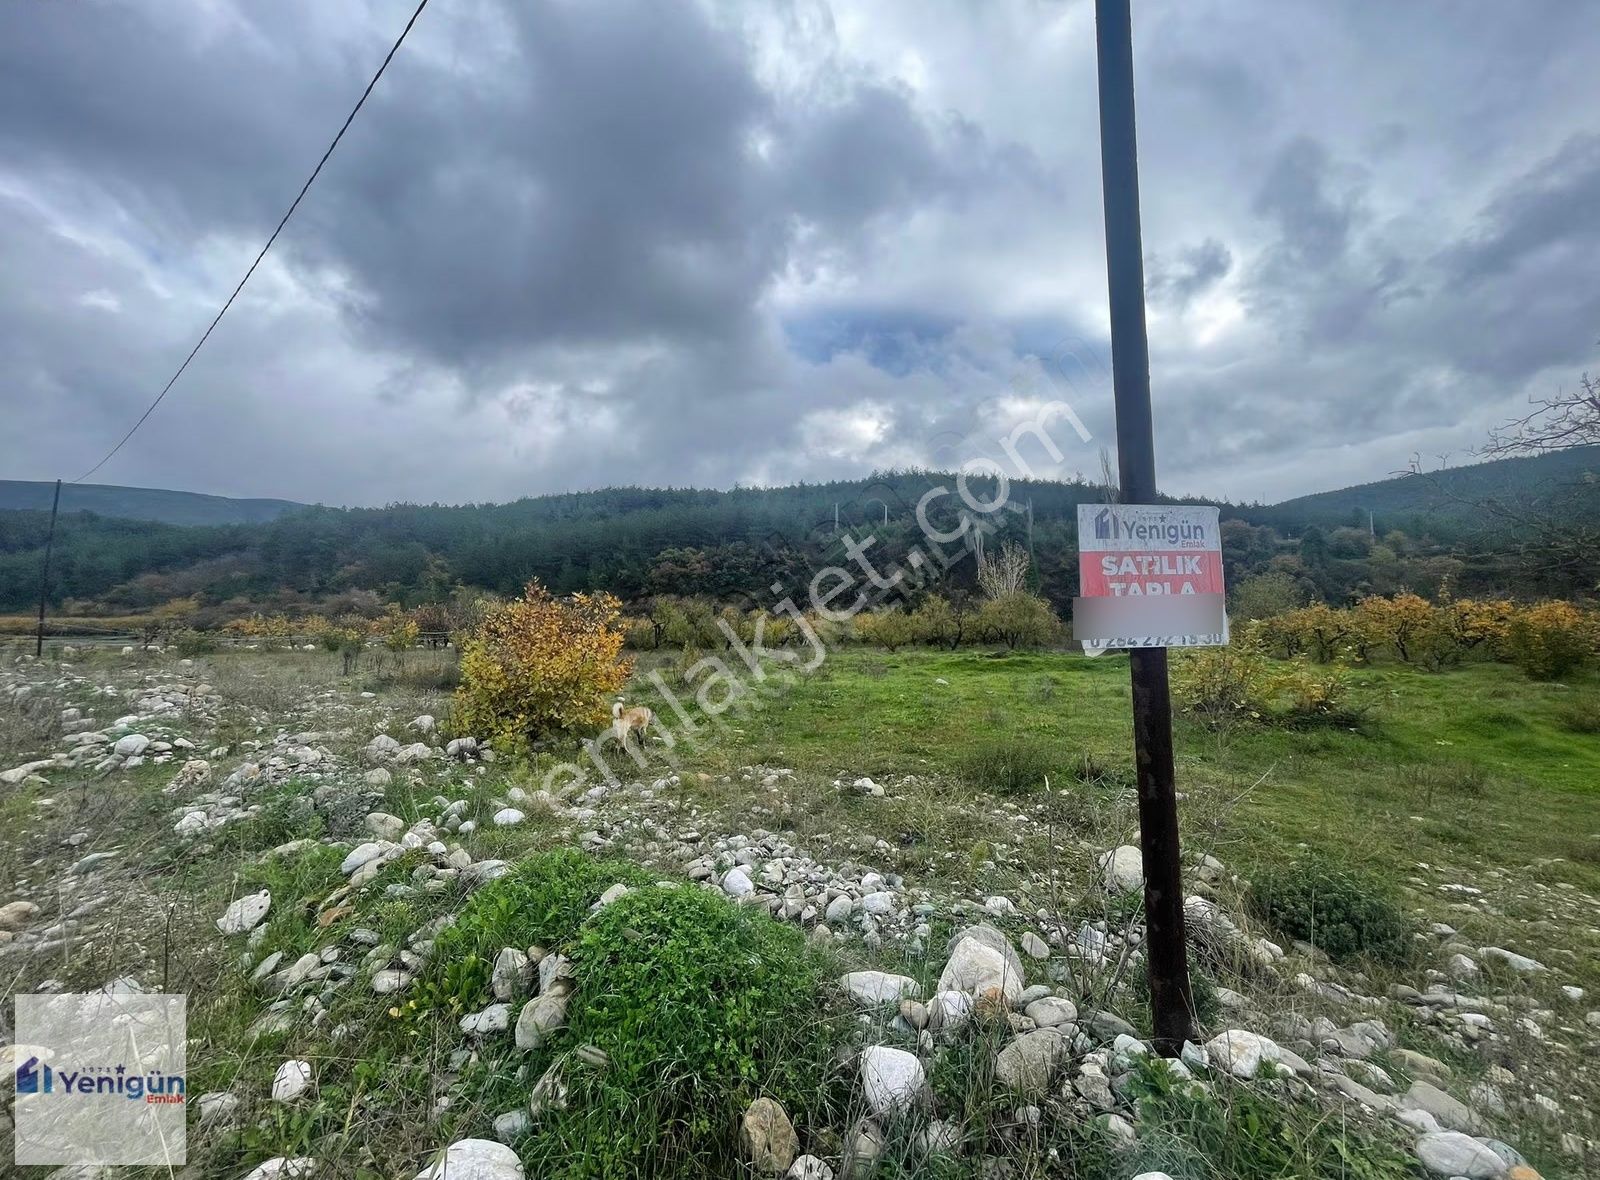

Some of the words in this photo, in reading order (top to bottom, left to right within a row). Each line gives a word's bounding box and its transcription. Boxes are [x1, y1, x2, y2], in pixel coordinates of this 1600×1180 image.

[1123, 520, 1205, 545] Yenigün
[1181, 540, 1206, 549] Emlak
[1101, 555, 1203, 576] SATILIK
